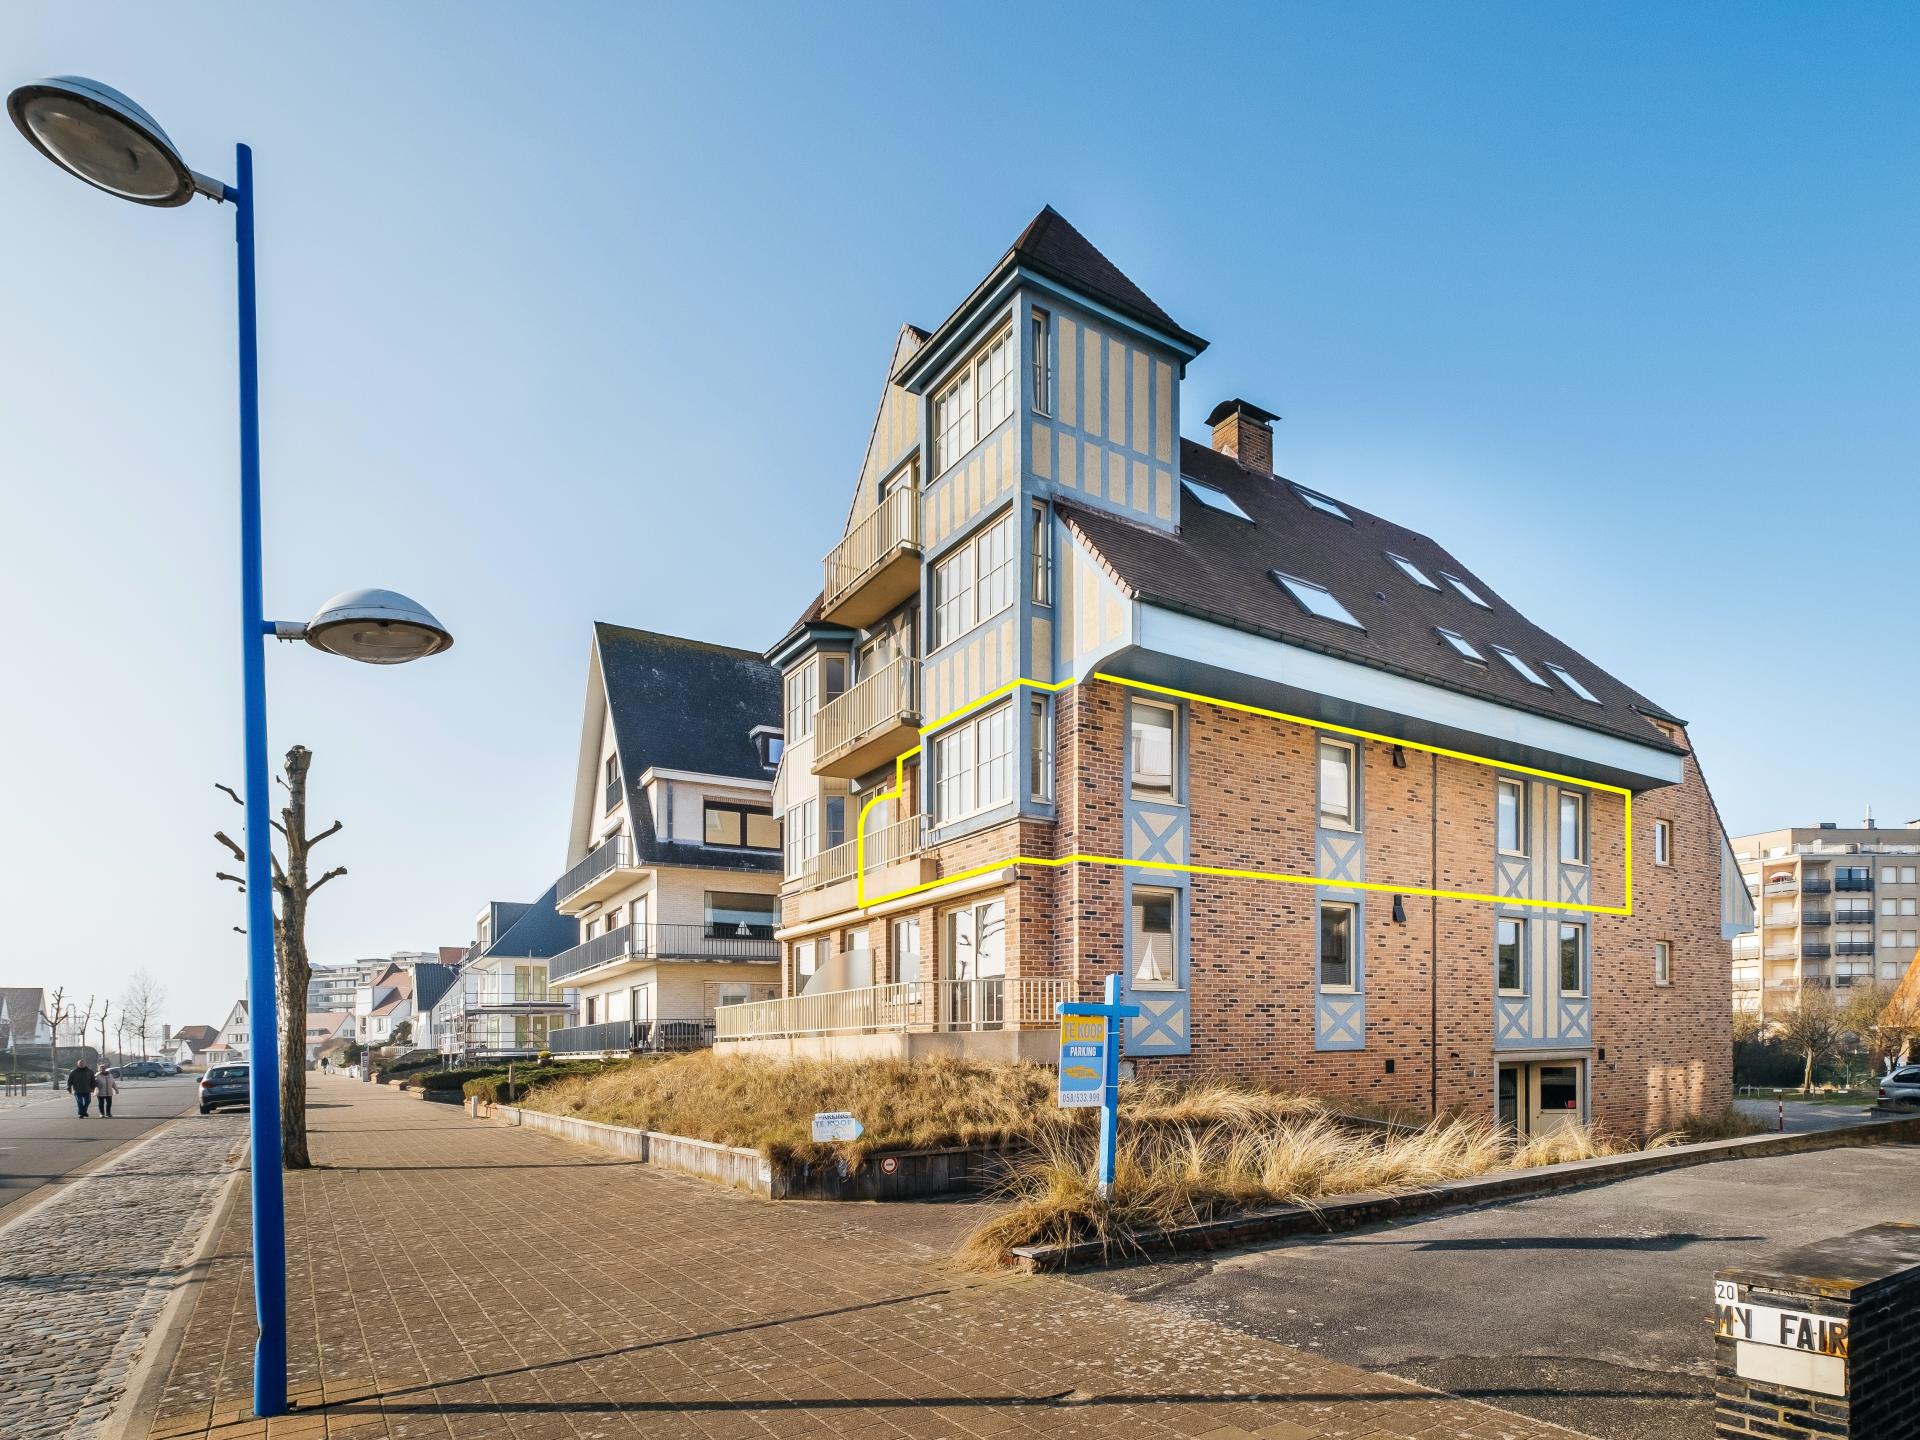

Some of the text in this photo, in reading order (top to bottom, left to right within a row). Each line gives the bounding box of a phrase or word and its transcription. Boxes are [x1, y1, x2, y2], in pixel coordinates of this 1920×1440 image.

[1065, 1023, 1103, 1039] TE KOOP
[1070, 1046, 1096, 1056] PARKING
[1717, 1284, 1734, 1300] 20
[1715, 1304, 1848, 1355] MY FAIR
